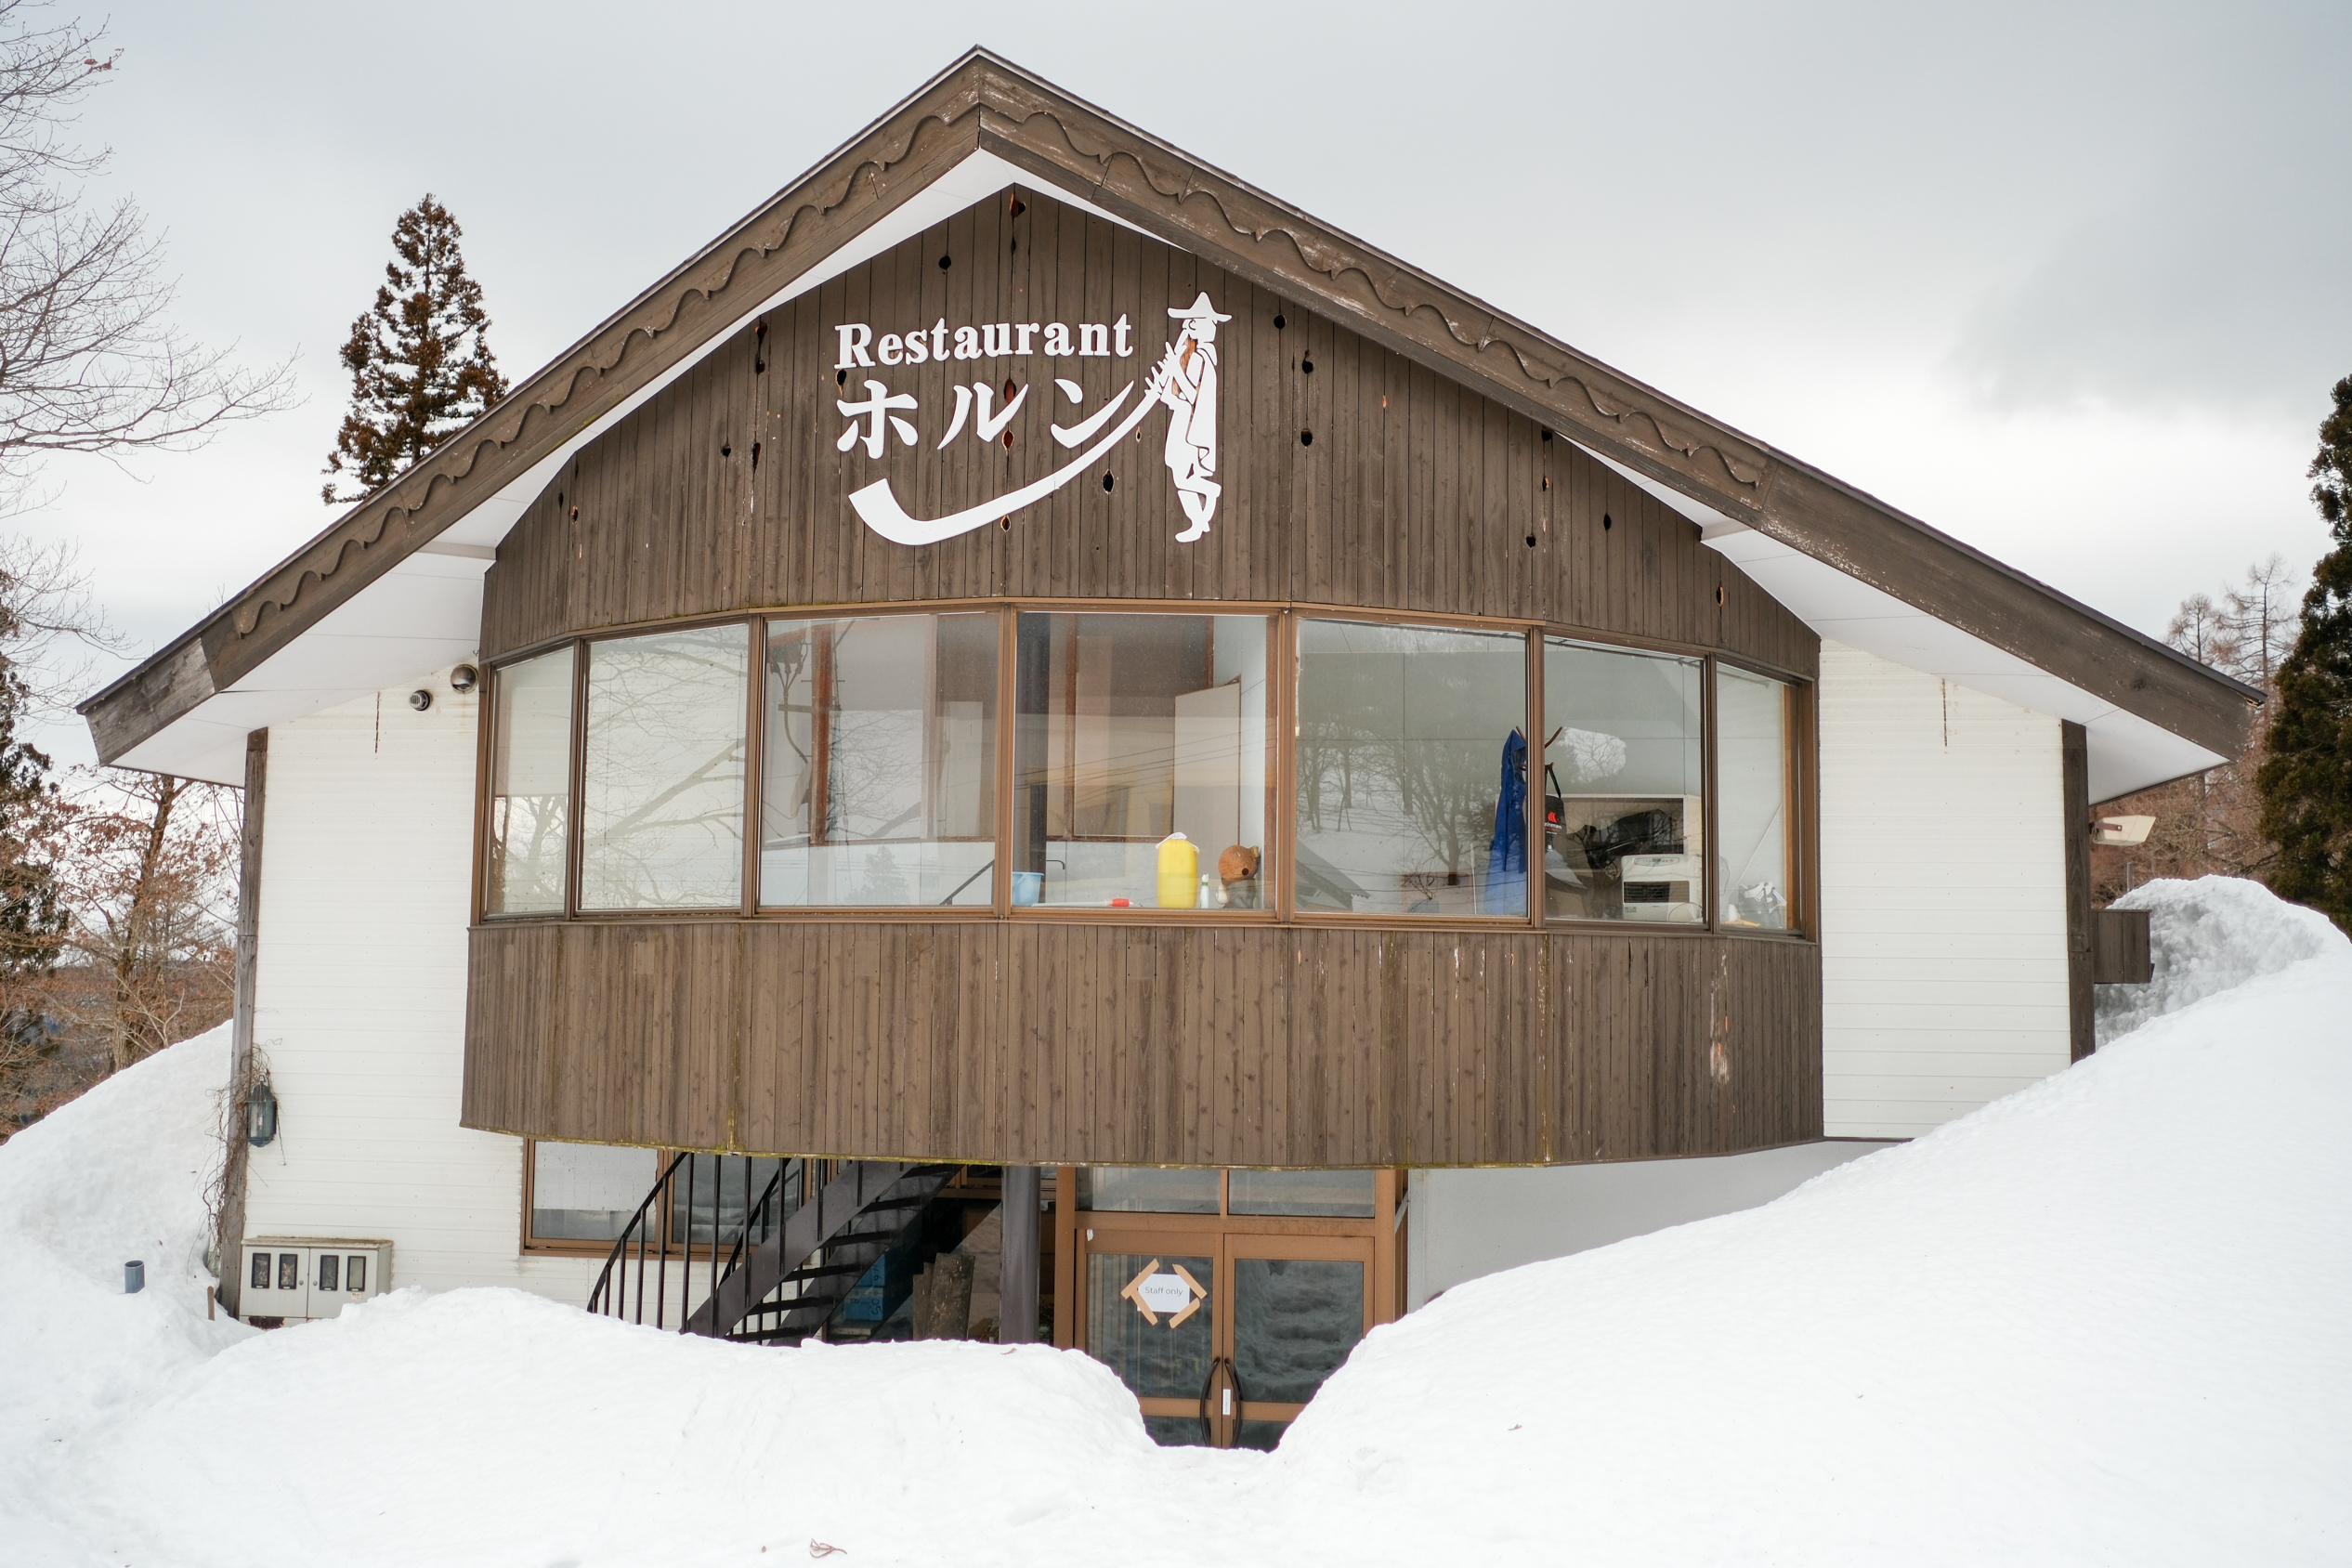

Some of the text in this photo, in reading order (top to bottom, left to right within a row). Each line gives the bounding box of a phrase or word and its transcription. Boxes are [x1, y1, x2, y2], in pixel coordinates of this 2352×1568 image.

[834, 313, 1133, 369] Restaurant
[837, 379, 1134, 459] ホルン
[1166, 1287, 1183, 1296] only
